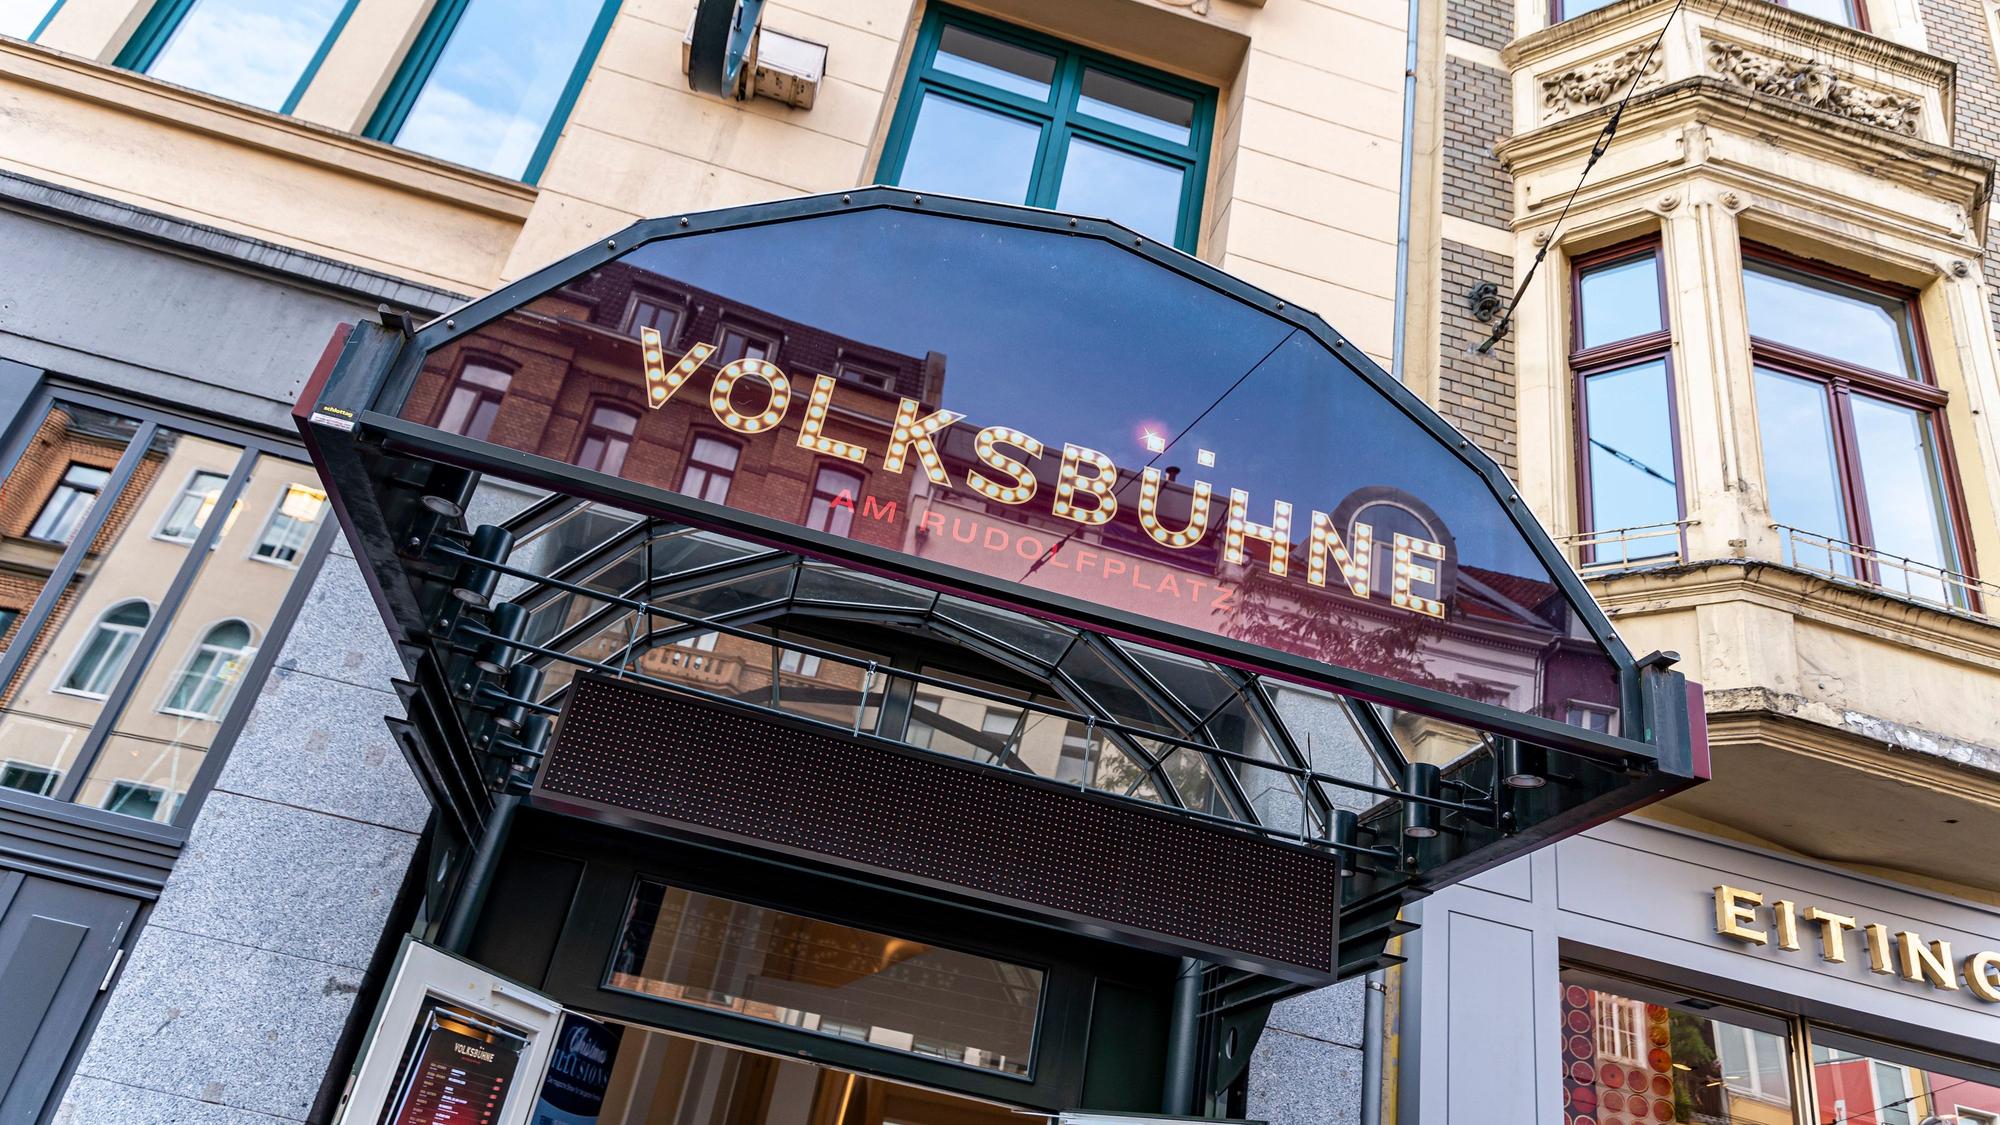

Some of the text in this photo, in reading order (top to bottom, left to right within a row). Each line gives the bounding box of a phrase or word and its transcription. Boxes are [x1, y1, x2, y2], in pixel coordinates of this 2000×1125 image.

[640, 326, 1446, 619] VOLKSBÜHNE
[829, 488, 1239, 611] AM RUDOLFPLATZ
[1713, 884, 2000, 1002] EITING
[454, 1043, 495, 1063] VOLKSBÜHNE
